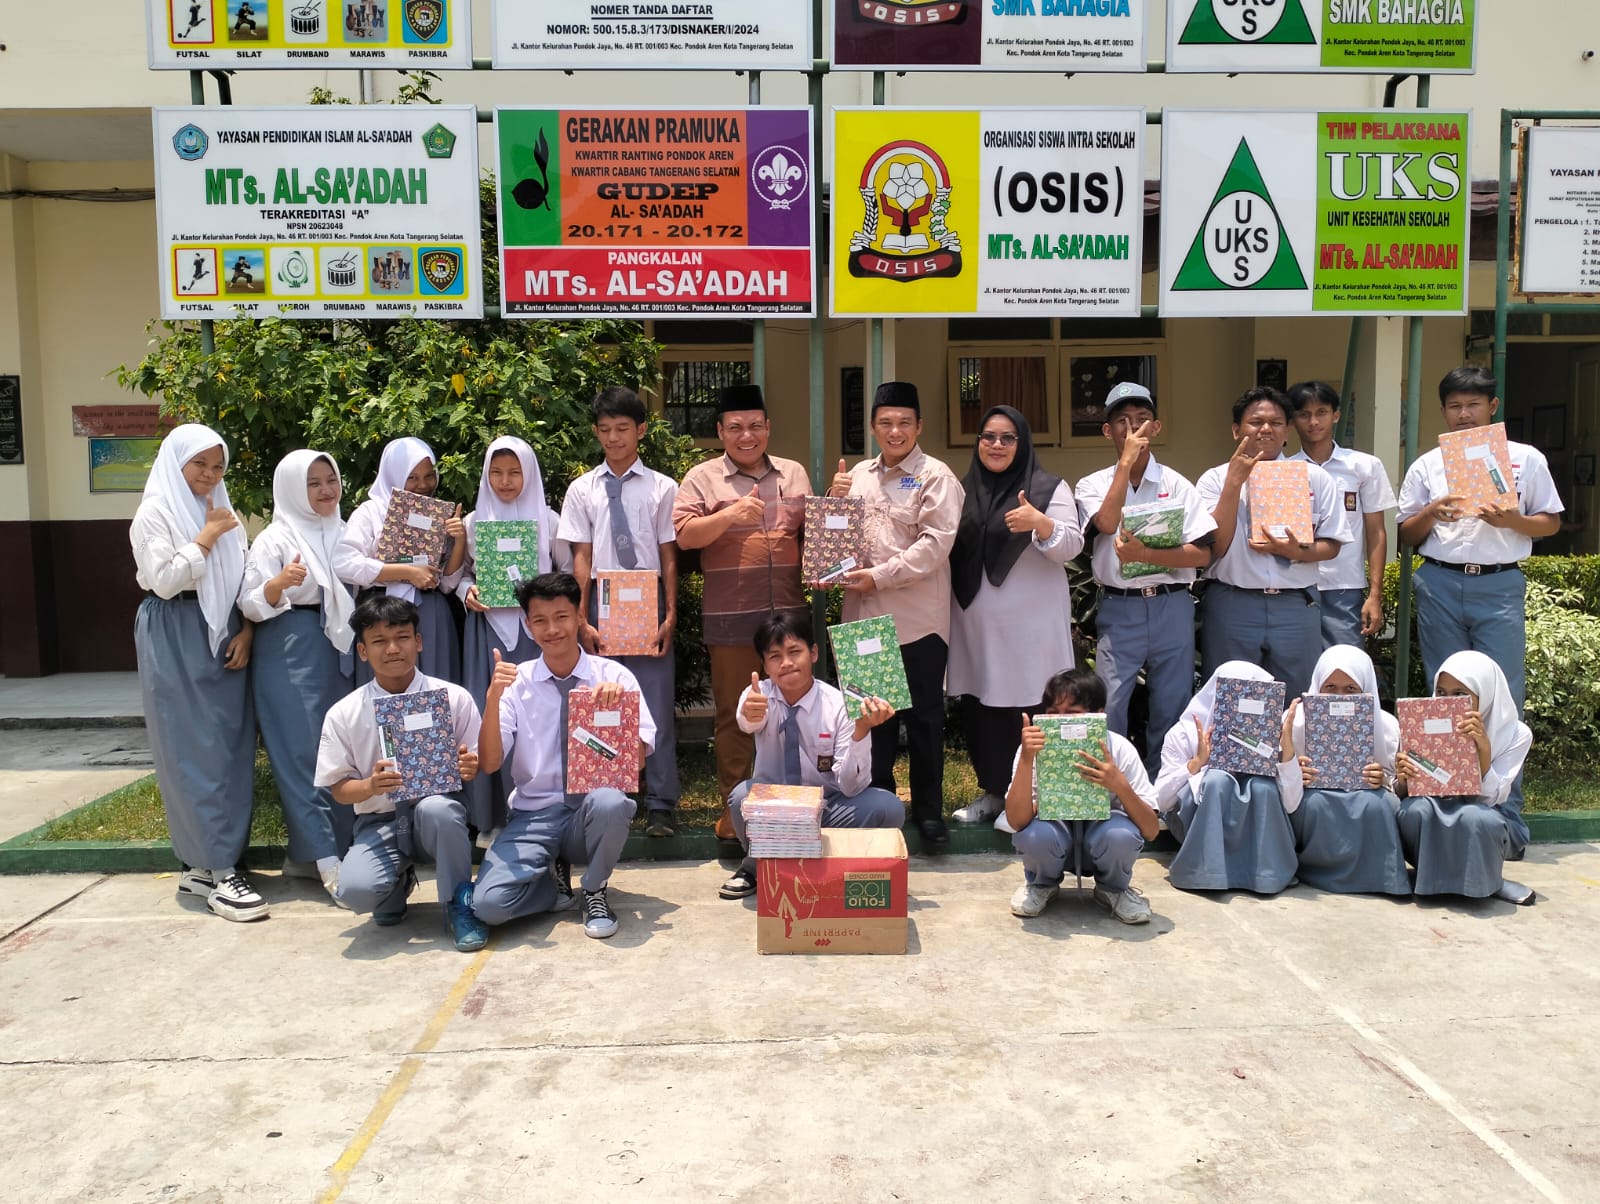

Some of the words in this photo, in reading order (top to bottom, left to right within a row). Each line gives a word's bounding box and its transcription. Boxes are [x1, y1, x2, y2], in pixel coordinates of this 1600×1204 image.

[591, 5, 629, 14] NOMER
[633, 5, 668, 14] TANDA
[672, 5, 712, 14] DAFTAR
[874, 6, 940, 22] OSIS
[1330, 0, 1372, 24] SMK
[1378, 0, 1464, 24] BAHAGIA
[547, 25, 590, 34] NOMOR:
[593, 24, 759, 35] 500.15.8.3/173/DISNAKER/I/2024
[1242, 8, 1257, 35] S
[597, 43, 612, 51] Jaya,
[738, 43, 769, 52] Tangerang
[217, 131, 260, 142] YAYASAN
[263, 131, 322, 143] PENDIDIKAN
[325, 131, 354, 143] ISLAM
[566, 118, 650, 143] GERAKAN
[656, 118, 740, 143] PRAMUKA
[1327, 122, 1357, 140] TIM
[1362, 123, 1460, 140] PELAKSANA
[984, 131, 1036, 148] ORGANISASI
[1039, 131, 1065, 148] SISWA
[1068, 131, 1093, 148] INTRA
[1096, 131, 1135, 148] SEKOLAH
[576, 151, 618, 161] KWARTIR
[621, 151, 663, 161] RANTING
[667, 151, 705, 161] PONDOK
[709, 151, 733, 160] AREN
[571, 167, 609, 176] KWARTIR
[612, 167, 646, 176] CABANG
[649, 167, 700, 177] TANGERANG
[703, 167, 740, 176] SELATAN
[1325, 153, 1461, 201] UKS
[205, 168, 265, 204] MTs.
[597, 183, 719, 200] GUDEP
[994, 166, 1124, 216] (OSIS)
[260, 210, 345, 219] TERAKREDITASI
[1235, 200, 1251, 224] U
[1327, 212, 1350, 226] UNIT
[1353, 212, 1406, 226] KESEHATAN
[1409, 212, 1449, 226] SEKOLAH
[259, 234, 275, 242] Jaya,
[406, 234, 438, 242] Tangerang
[568, 225, 643, 238] 20.171
[667, 225, 743, 237] 20.172
[988, 234, 1026, 259] MTs.
[1215, 228, 1268, 253] UKS
[608, 252, 702, 265] PANGKALAN
[1320, 244, 1358, 269] MTs.
[875, 258, 937, 274] OSIS
[1234, 256, 1249, 281] S
[525, 271, 595, 295] MTs.
[602, 304, 617, 312] Jaya,
[747, 304, 778, 312] Tangerang
[849, 897, 885, 906] FOLIO
[803, 928, 860, 936] PAPERLINE
